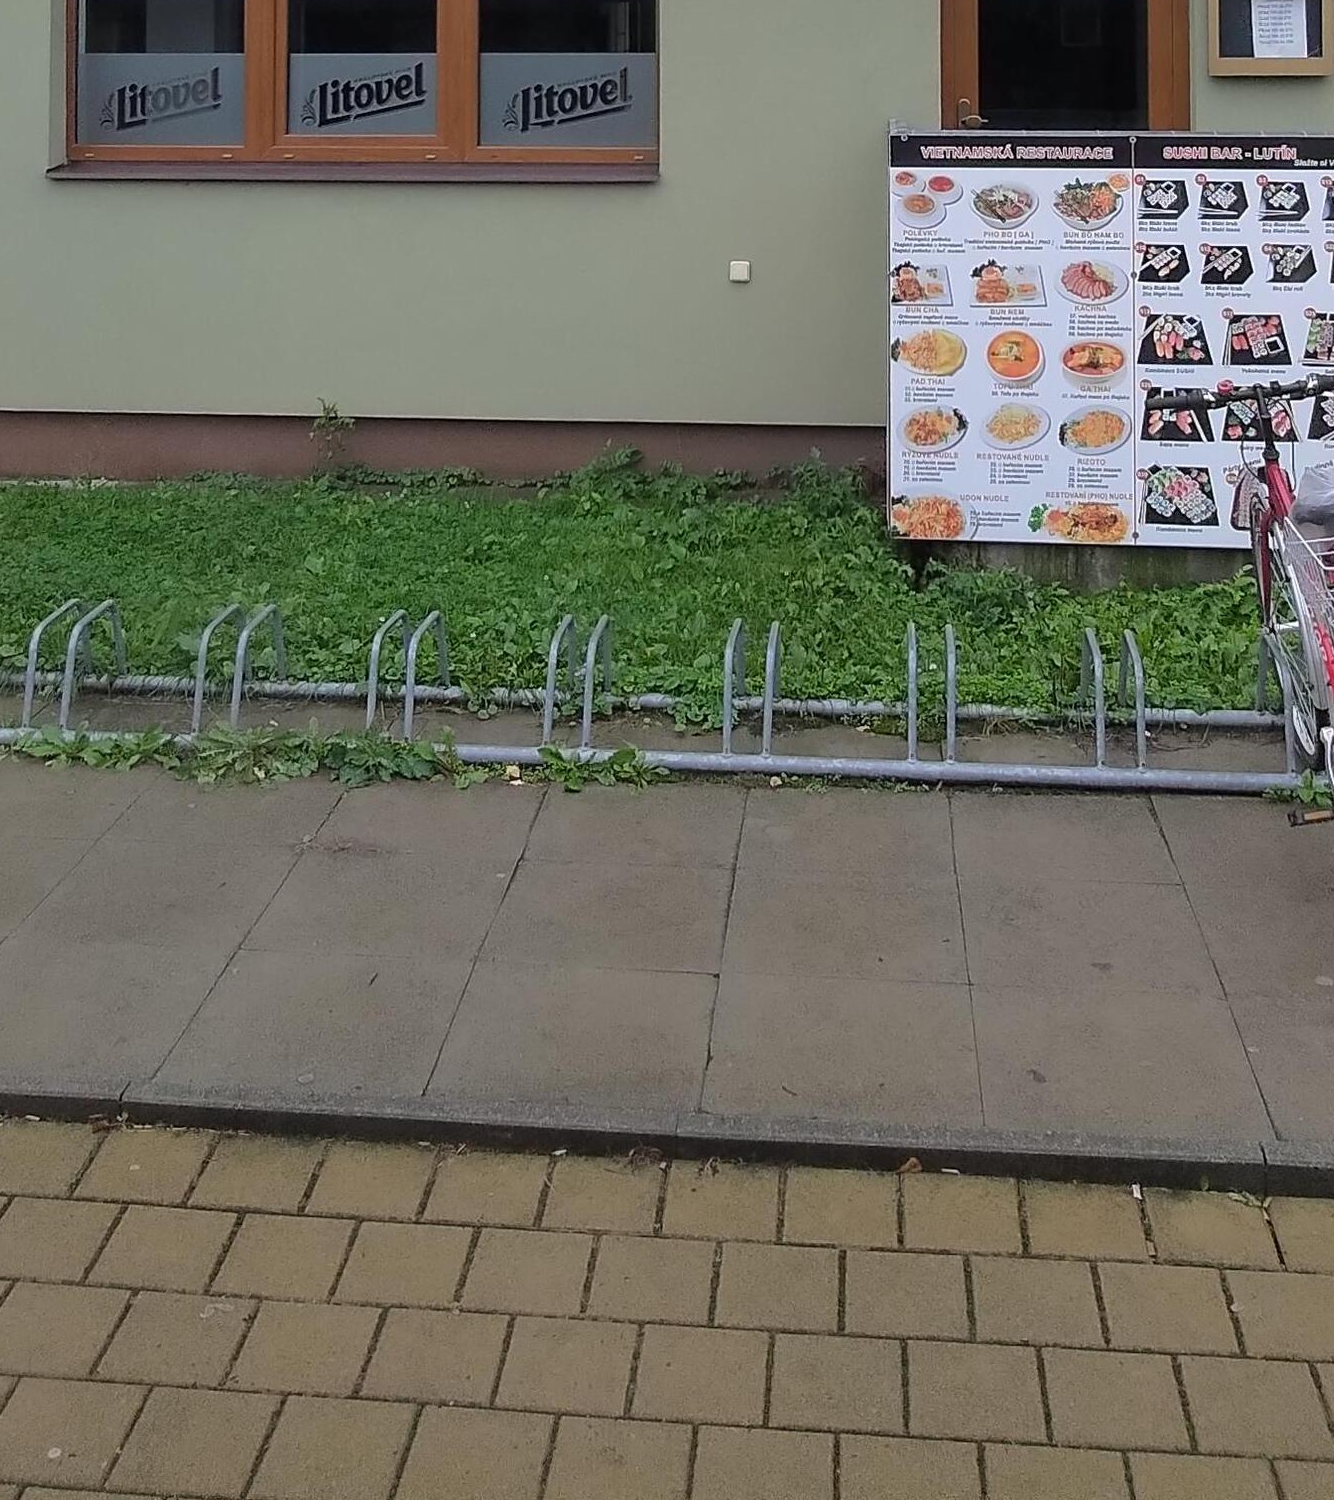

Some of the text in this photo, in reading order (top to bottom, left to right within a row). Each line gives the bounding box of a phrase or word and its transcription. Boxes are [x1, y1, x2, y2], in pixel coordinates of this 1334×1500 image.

[117, 66, 223, 130] Litovel
[317, 62, 427, 127] Litovel
[521, 67, 632, 132] Litovel
[920, 144, 1114, 160] VIETNAMSKÁ RESTAURACE
[1163, 147, 1208, 160] SUSHI
[1211, 147, 1242, 160] BAR
[1253, 145, 1297, 160] LUTÍN
